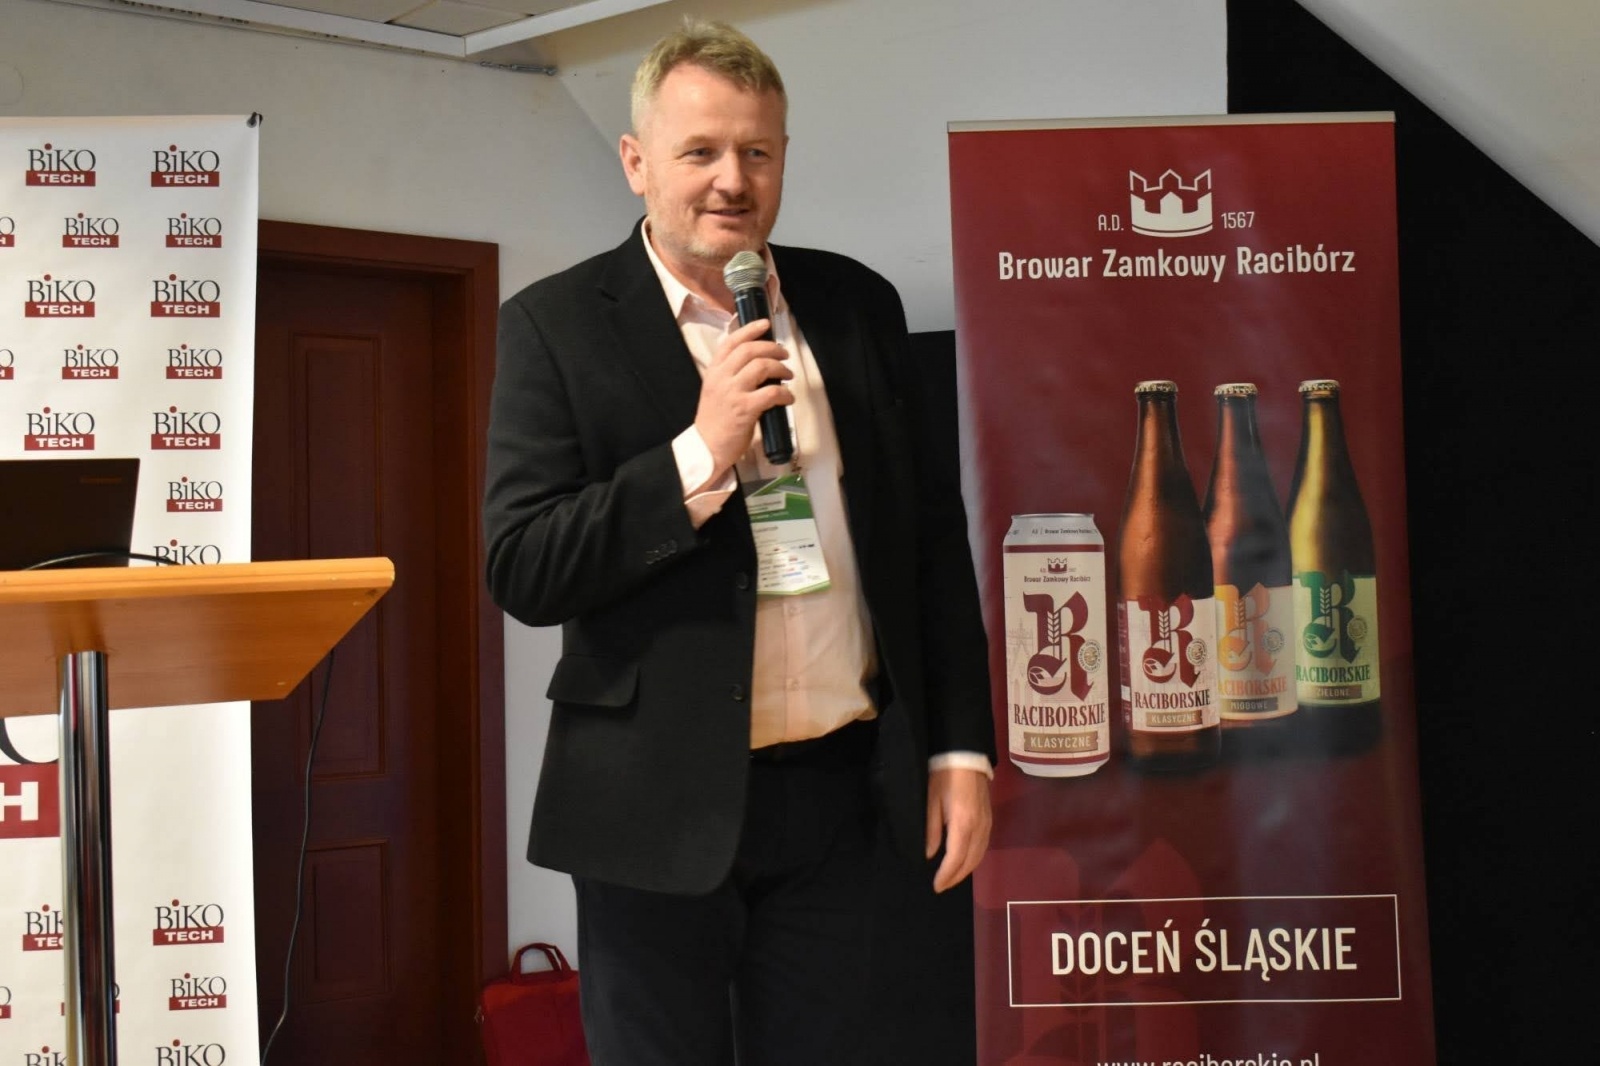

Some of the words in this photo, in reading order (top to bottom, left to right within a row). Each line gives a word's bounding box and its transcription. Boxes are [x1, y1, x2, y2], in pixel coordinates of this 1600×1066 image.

[37, 173, 85, 183] TECH
[162, 174, 209, 184] TECH
[1097, 214, 1125, 231] A.D.
[1221, 211, 1256, 229] 1567
[72, 237, 110, 245] TECH
[175, 237, 213, 245] TECH
[998, 251, 1093, 280] Browar
[1102, 248, 1226, 283] Zamkowy
[1237, 243, 1356, 275] Racibórz
[36, 304, 85, 314] TECH
[162, 304, 210, 314] TECH
[71, 369, 110, 377] TECH
[175, 369, 214, 377] TECH
[35, 438, 85, 448] TECH
[162, 437, 211, 447] TECH
[176, 501, 215, 510] TECH
[1296, 664, 1371, 683] RACIBORSKIE
[1317, 688, 1350, 697] ZIELONE
[1134, 689, 1211, 709] RACIBORSKIE
[1230, 701, 1268, 710] MIODOWE
[1014, 703, 1106, 727] RACIBORSKIE
[1151, 712, 1196, 724] KLASYCZNE
[1030, 734, 1091, 749] KLASYCZNE
[165, 930, 214, 942] TECH
[1051, 919, 1181, 976] DOCEŃ
[1194, 917, 1358, 983] ŚLĄSKIE
[178, 998, 218, 1008] TECH
